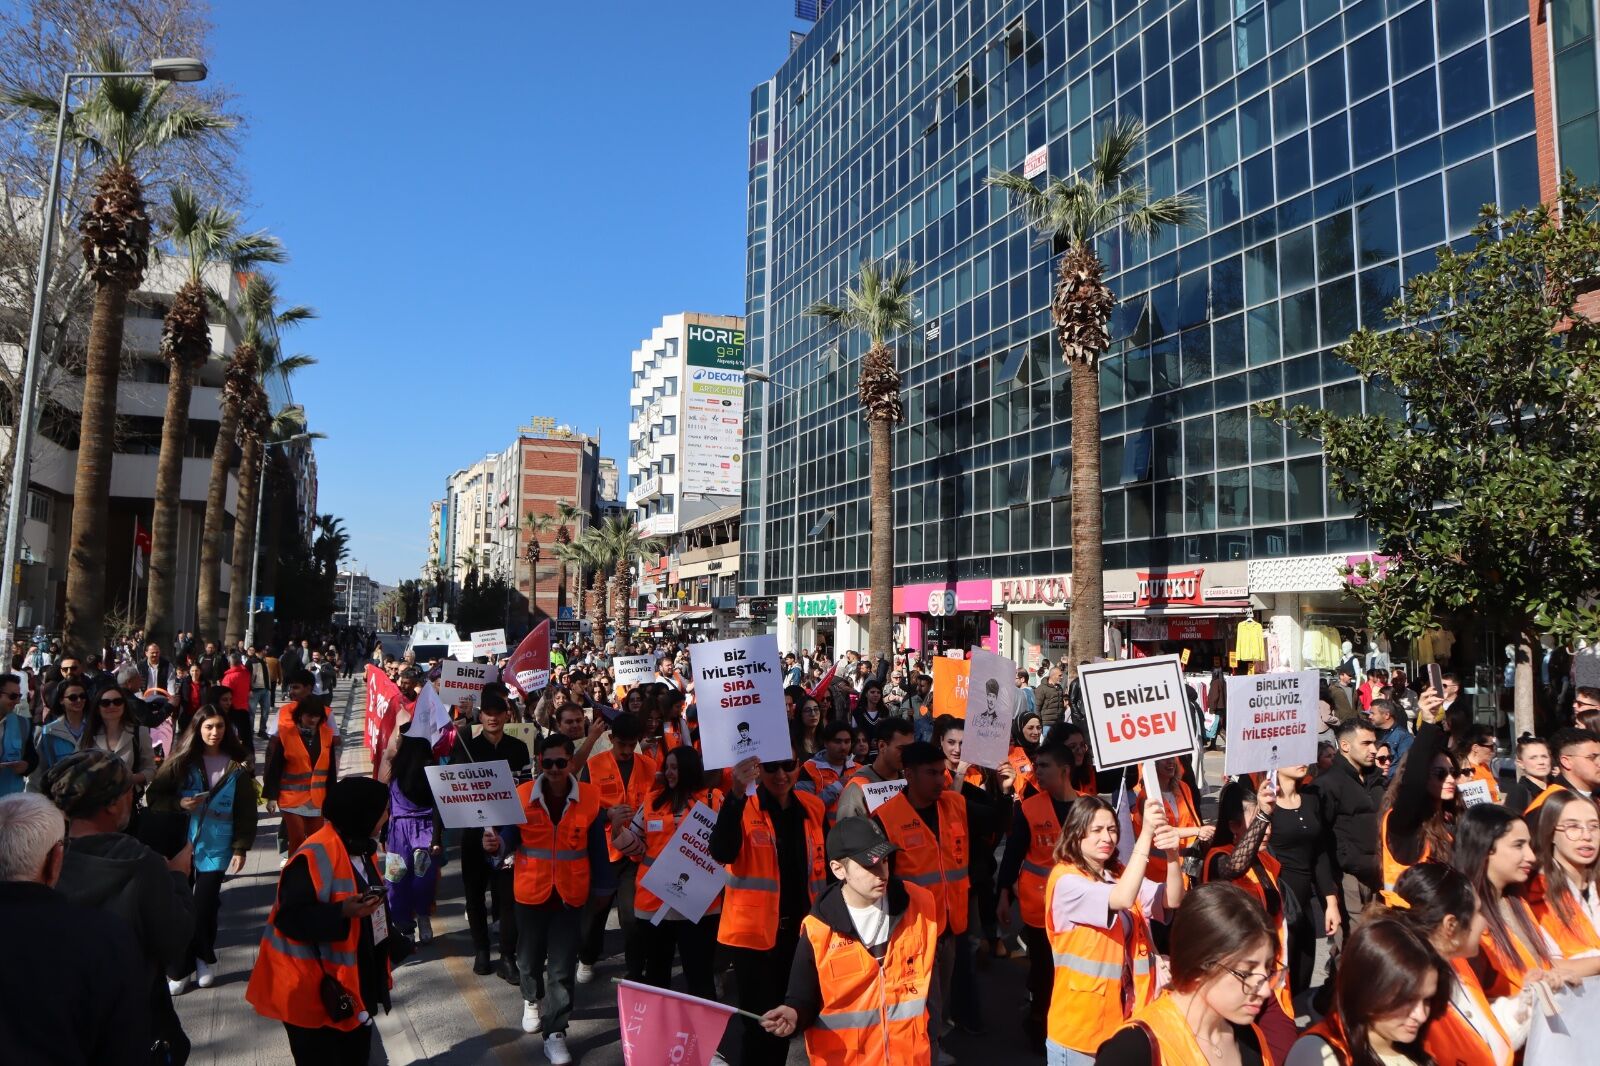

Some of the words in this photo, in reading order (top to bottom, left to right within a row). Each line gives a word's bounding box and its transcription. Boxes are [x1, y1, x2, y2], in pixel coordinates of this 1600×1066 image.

[1000, 577, 1072, 606] HALKTA
[1139, 578, 1196, 600] TUTKU
[857, 591, 871, 614] Pe
[620, 658, 649, 666] BİRLİKTE
[724, 648, 747, 662] BİZ
[456, 666, 486, 679] BİRİZ
[618, 666, 652, 675] GÜÇLÜYÜZ
[702, 661, 772, 680] İYİLEŞTİK,
[444, 680, 487, 691] BERABER
[723, 680, 755, 693] SIRA
[1256, 677, 1299, 692] BİRLİKTE
[720, 693, 762, 709] SİZDE
[1103, 680, 1170, 709] DENİZLİ
[1254, 709, 1297, 724] BİRLİKTE
[1106, 711, 1177, 743] LÖSEV
[1242, 721, 1307, 741] İYİLEŞECEĞİZ
[439, 770, 456, 781] SİZ
[458, 767, 498, 780] GÜLÜN,
[451, 782, 469, 792] BİZ
[470, 780, 492, 790] HEP
[867, 785, 889, 795] Hayat
[440, 790, 513, 804] YANINIZDAYIZ!
[679, 845, 716, 875] GENÇLİK
